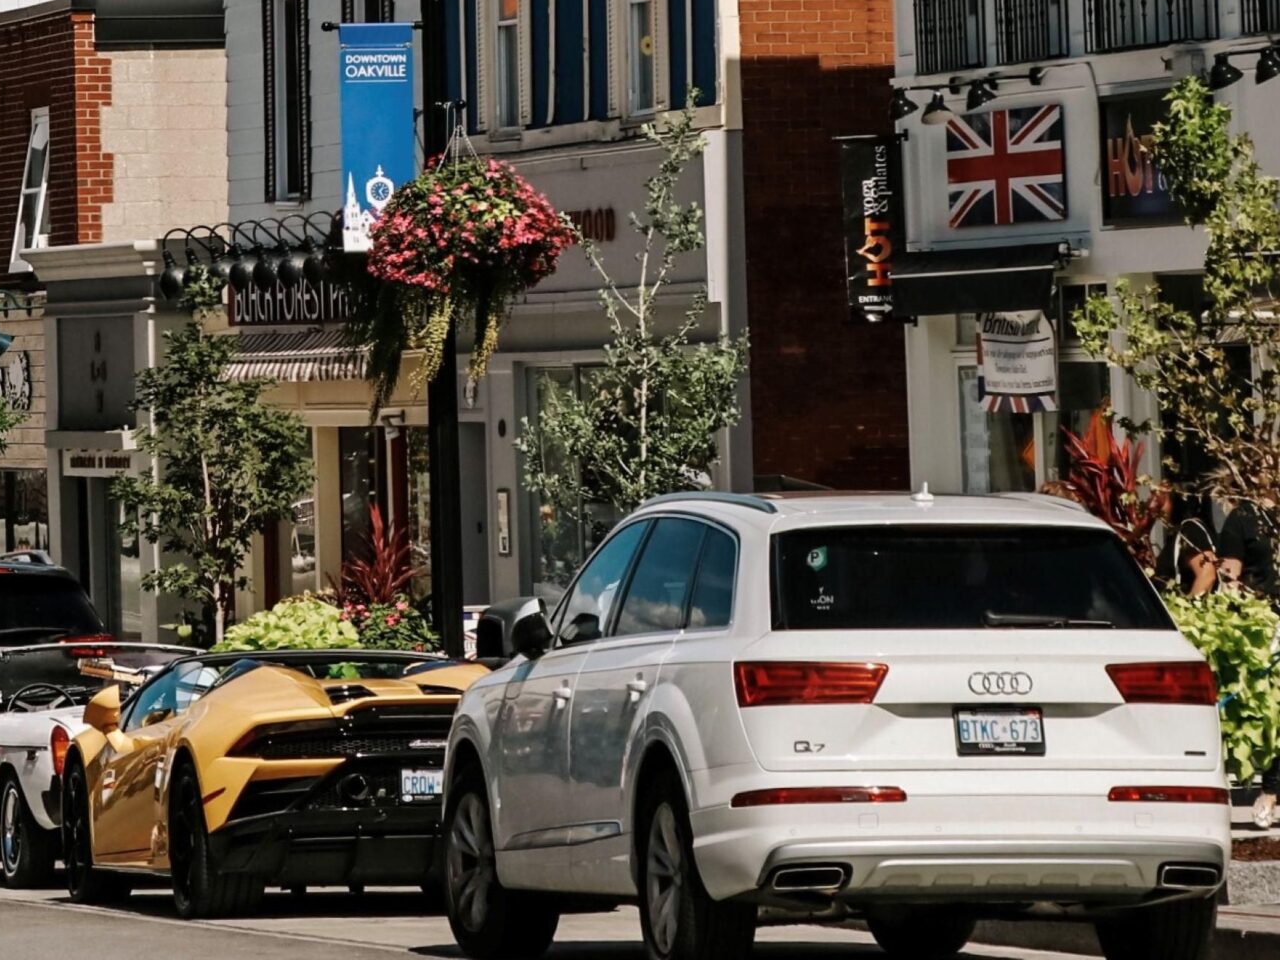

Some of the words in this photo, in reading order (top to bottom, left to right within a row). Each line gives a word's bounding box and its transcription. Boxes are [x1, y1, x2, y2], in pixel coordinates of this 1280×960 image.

[345, 54, 407, 64] DOWNTOWN
[345, 64, 407, 77] OAKVILLE
[872, 145, 893, 195] pilates
[862, 179, 878, 216] yoga
[856, 217, 893, 287] HOT
[276, 278, 324, 320] FOREST
[858, 295, 894, 303] ENTRANC
[961, 719, 1000, 741] BTKC
[1009, 719, 1040, 741] 673
[794, 741, 825, 753] Q7
